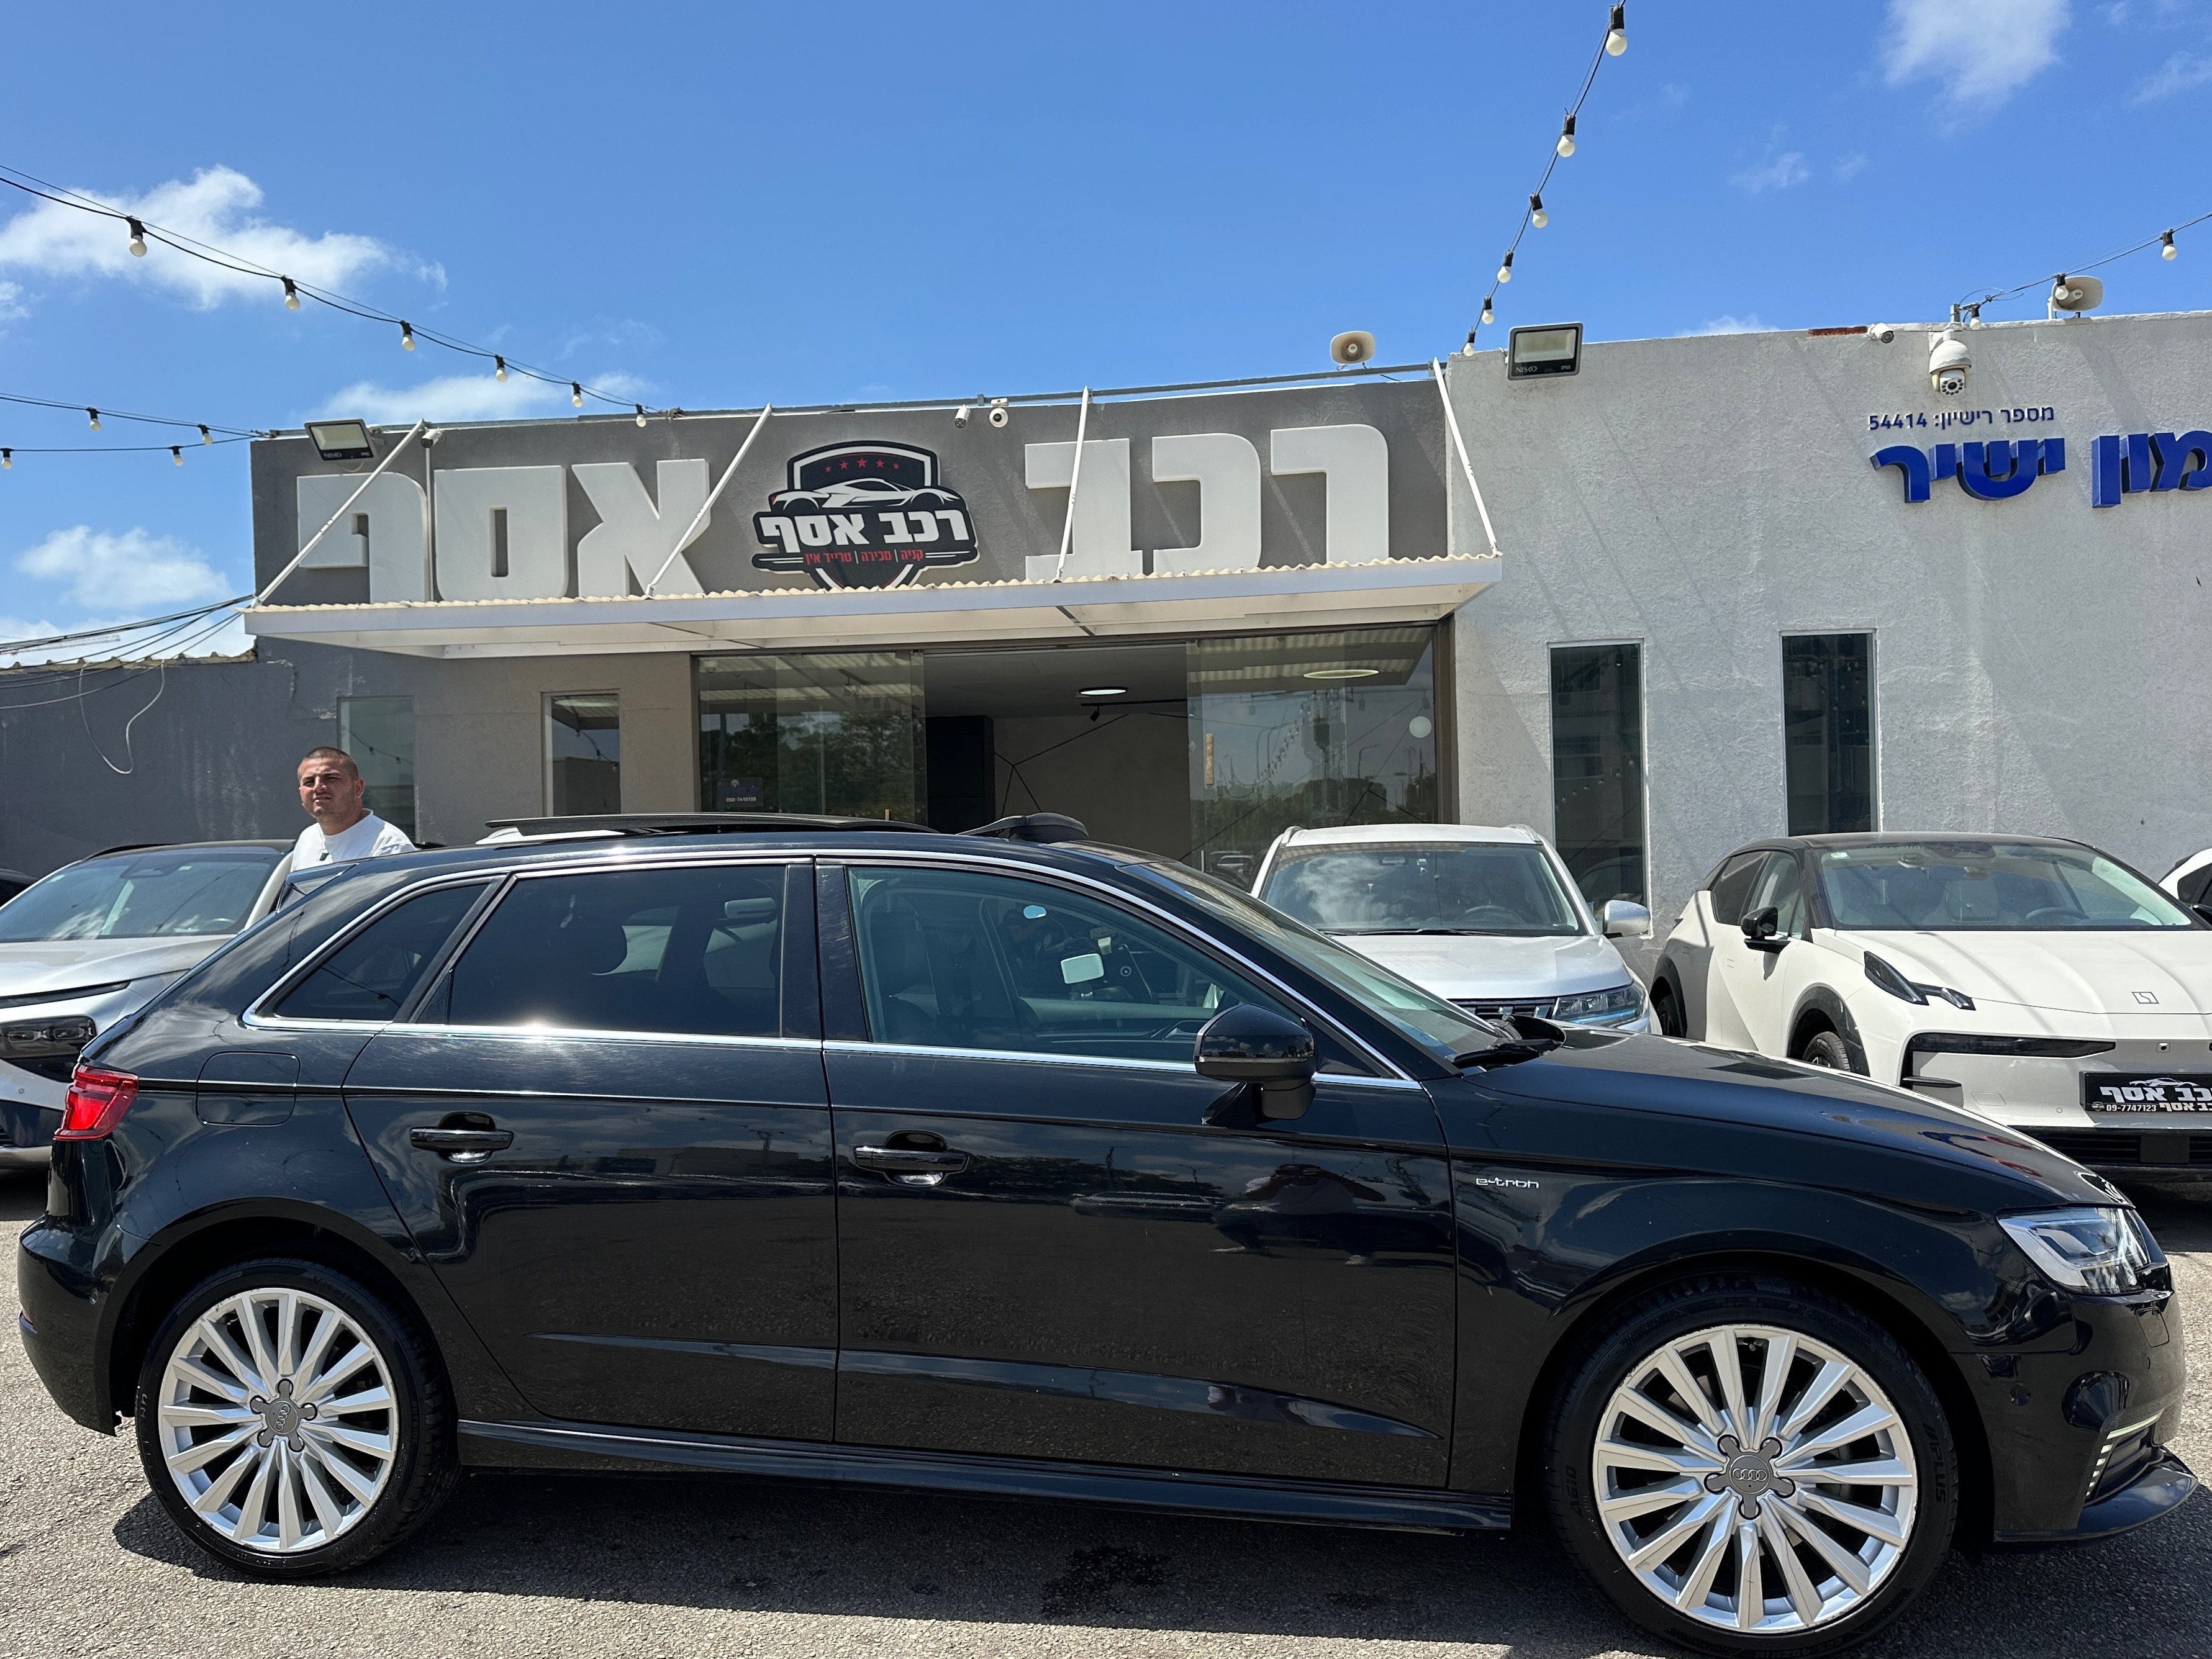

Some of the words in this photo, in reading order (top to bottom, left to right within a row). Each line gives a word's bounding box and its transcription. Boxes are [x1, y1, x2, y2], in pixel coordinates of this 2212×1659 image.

[1868, 412, 1928, 430] 54414
[1934, 410, 1993, 430] רישיון:
[1999, 407, 2054, 423] מספר
[1869, 438, 2066, 504] ישיר
[1025, 424, 1389, 582] רכב
[297, 458, 710, 603] אסף
[759, 513, 869, 553] אסף
[878, 510, 969, 543] רכב
[804, 553, 821, 566] אין
[823, 552, 853, 563] טרייד
[859, 551, 892, 561] מכירה
[900, 549, 924, 561] קניה
[2099, 1087, 2168, 1103] אסף
[2174, 1087, 2212, 1101] כב
[2106, 1104, 2157, 1112] 09-7747123
[2159, 1103, 2196, 1112] אסף
[1475, 1177, 1539, 1189] e-tron
